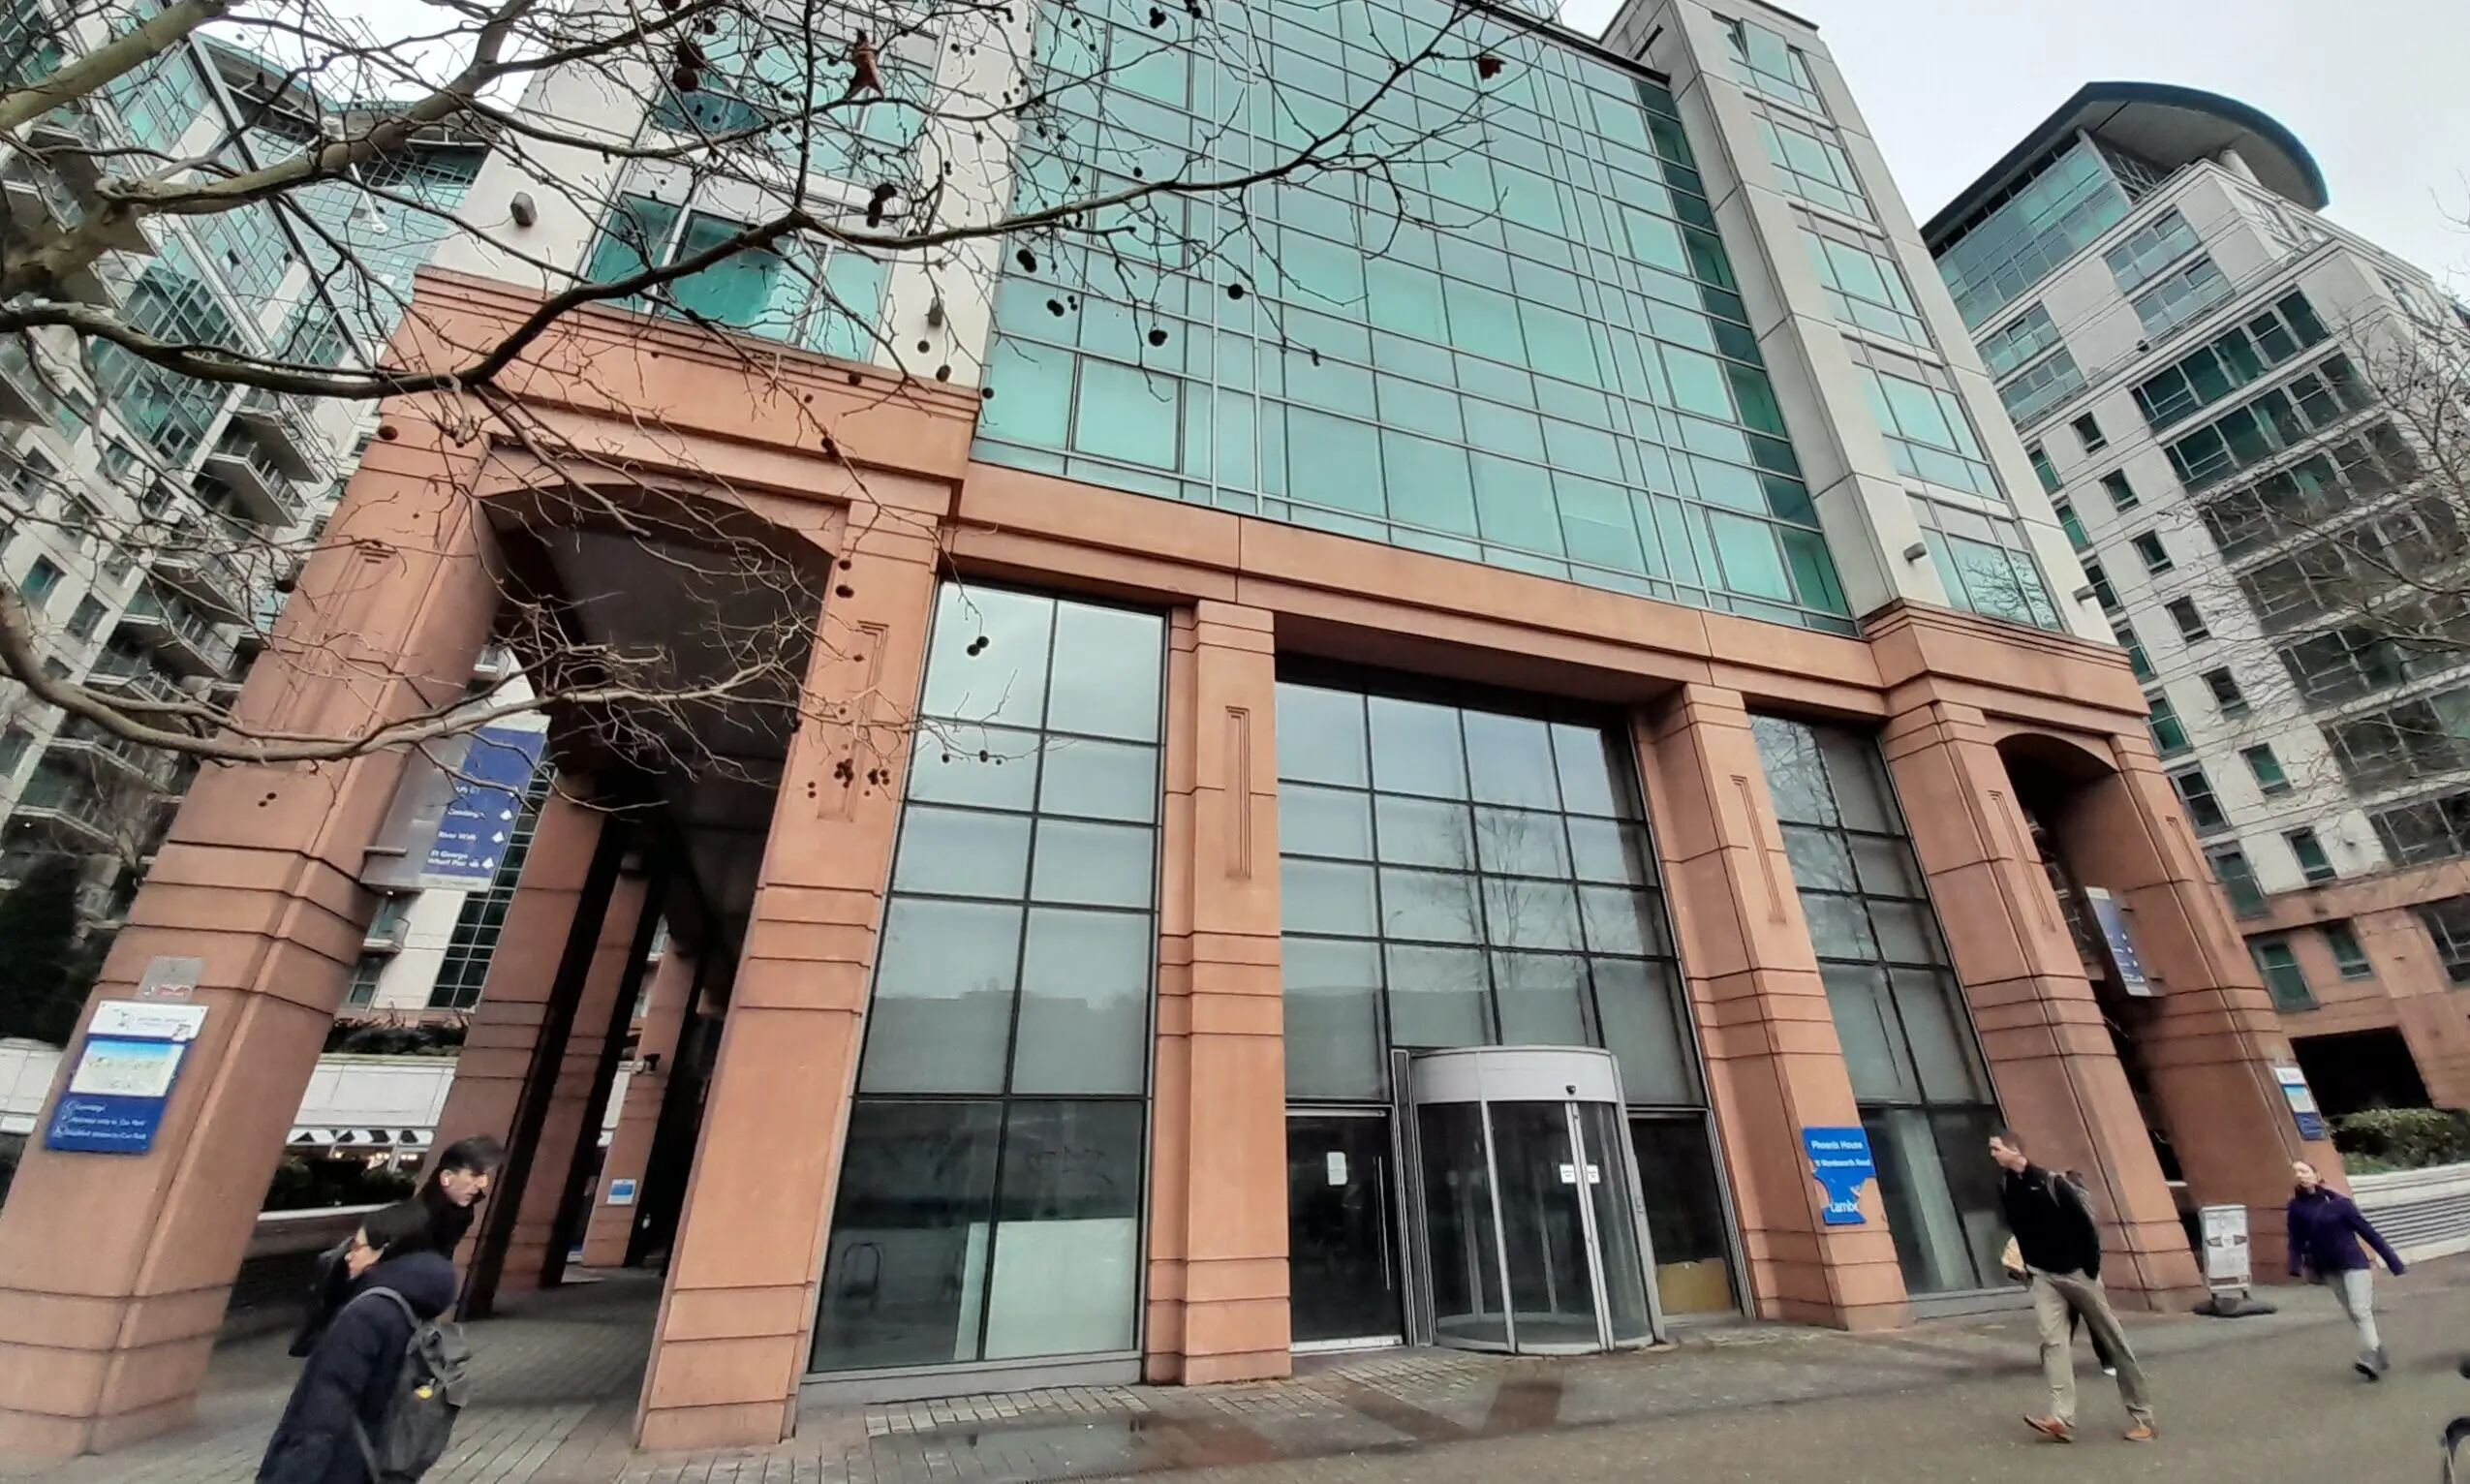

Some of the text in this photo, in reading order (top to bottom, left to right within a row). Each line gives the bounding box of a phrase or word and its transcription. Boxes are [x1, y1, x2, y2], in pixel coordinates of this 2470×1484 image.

[441, 850, 468, 860] George
[1810, 1140, 1864, 1150] Phoenix House
[1855, 1159, 1870, 1167] Road
